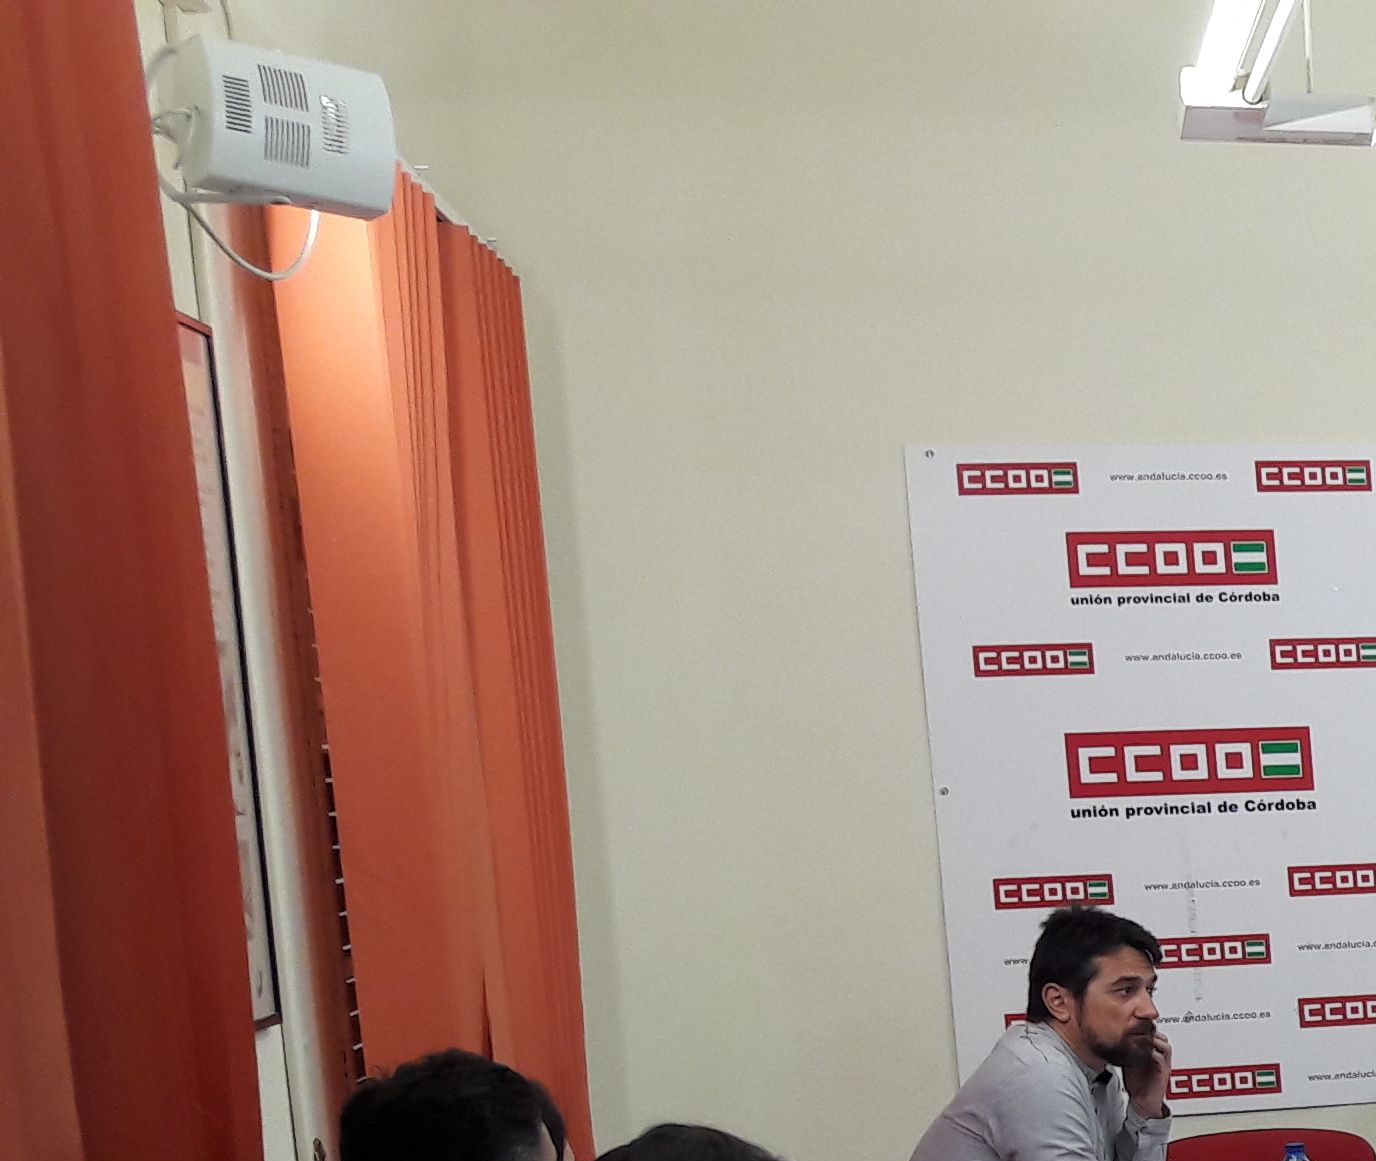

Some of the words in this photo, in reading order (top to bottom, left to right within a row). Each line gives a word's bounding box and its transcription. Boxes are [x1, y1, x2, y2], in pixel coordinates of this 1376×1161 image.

[963, 470, 1049, 488] CCOO
[1261, 467, 1344, 485] CCOO
[1077, 543, 1226, 575] CCOO
[1071, 595, 1112, 605] unión
[1118, 593, 1190, 606] provincial
[1196, 593, 1213, 602] de
[1219, 592, 1279, 602] Córdoba
[979, 651, 1064, 670] CCOO
[1275, 644, 1357, 663] CCOO
[1078, 744, 1254, 784] CCOO
[1071, 805, 1119, 818] unión
[1126, 802, 1211, 819] provincial
[1218, 801, 1238, 813] de
[1245, 799, 1316, 812] Córdoba
[1294, 870, 1374, 890] CCOO
[1000, 882, 1084, 902] CCOO
[1161, 942, 1242, 962] CCOO
[1170, 1072, 1253, 1093] CCOO
